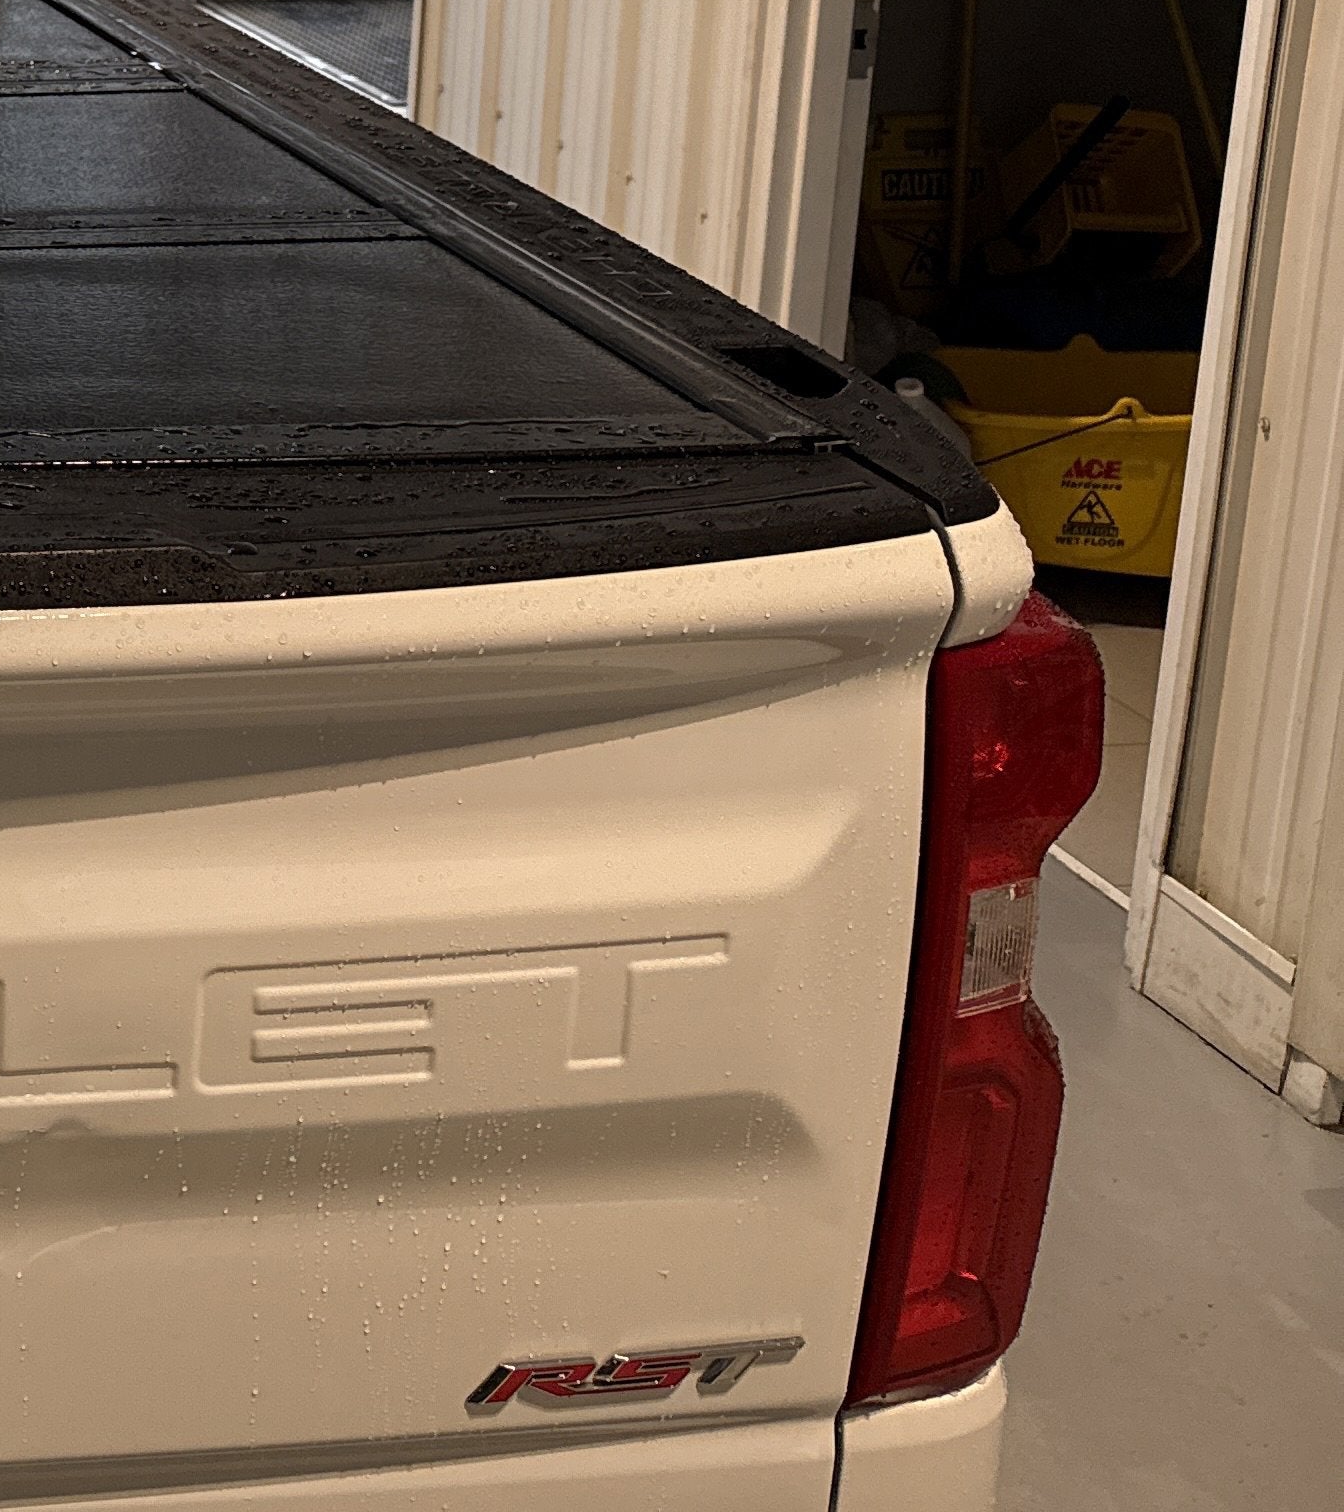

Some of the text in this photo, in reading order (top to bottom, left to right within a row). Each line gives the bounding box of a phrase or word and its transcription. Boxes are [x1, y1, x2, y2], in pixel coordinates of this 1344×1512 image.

[1062, 456, 1123, 480] ACE
[1055, 535, 1125, 547] WET FLOOR
[465, 1335, 805, 1405] RST
